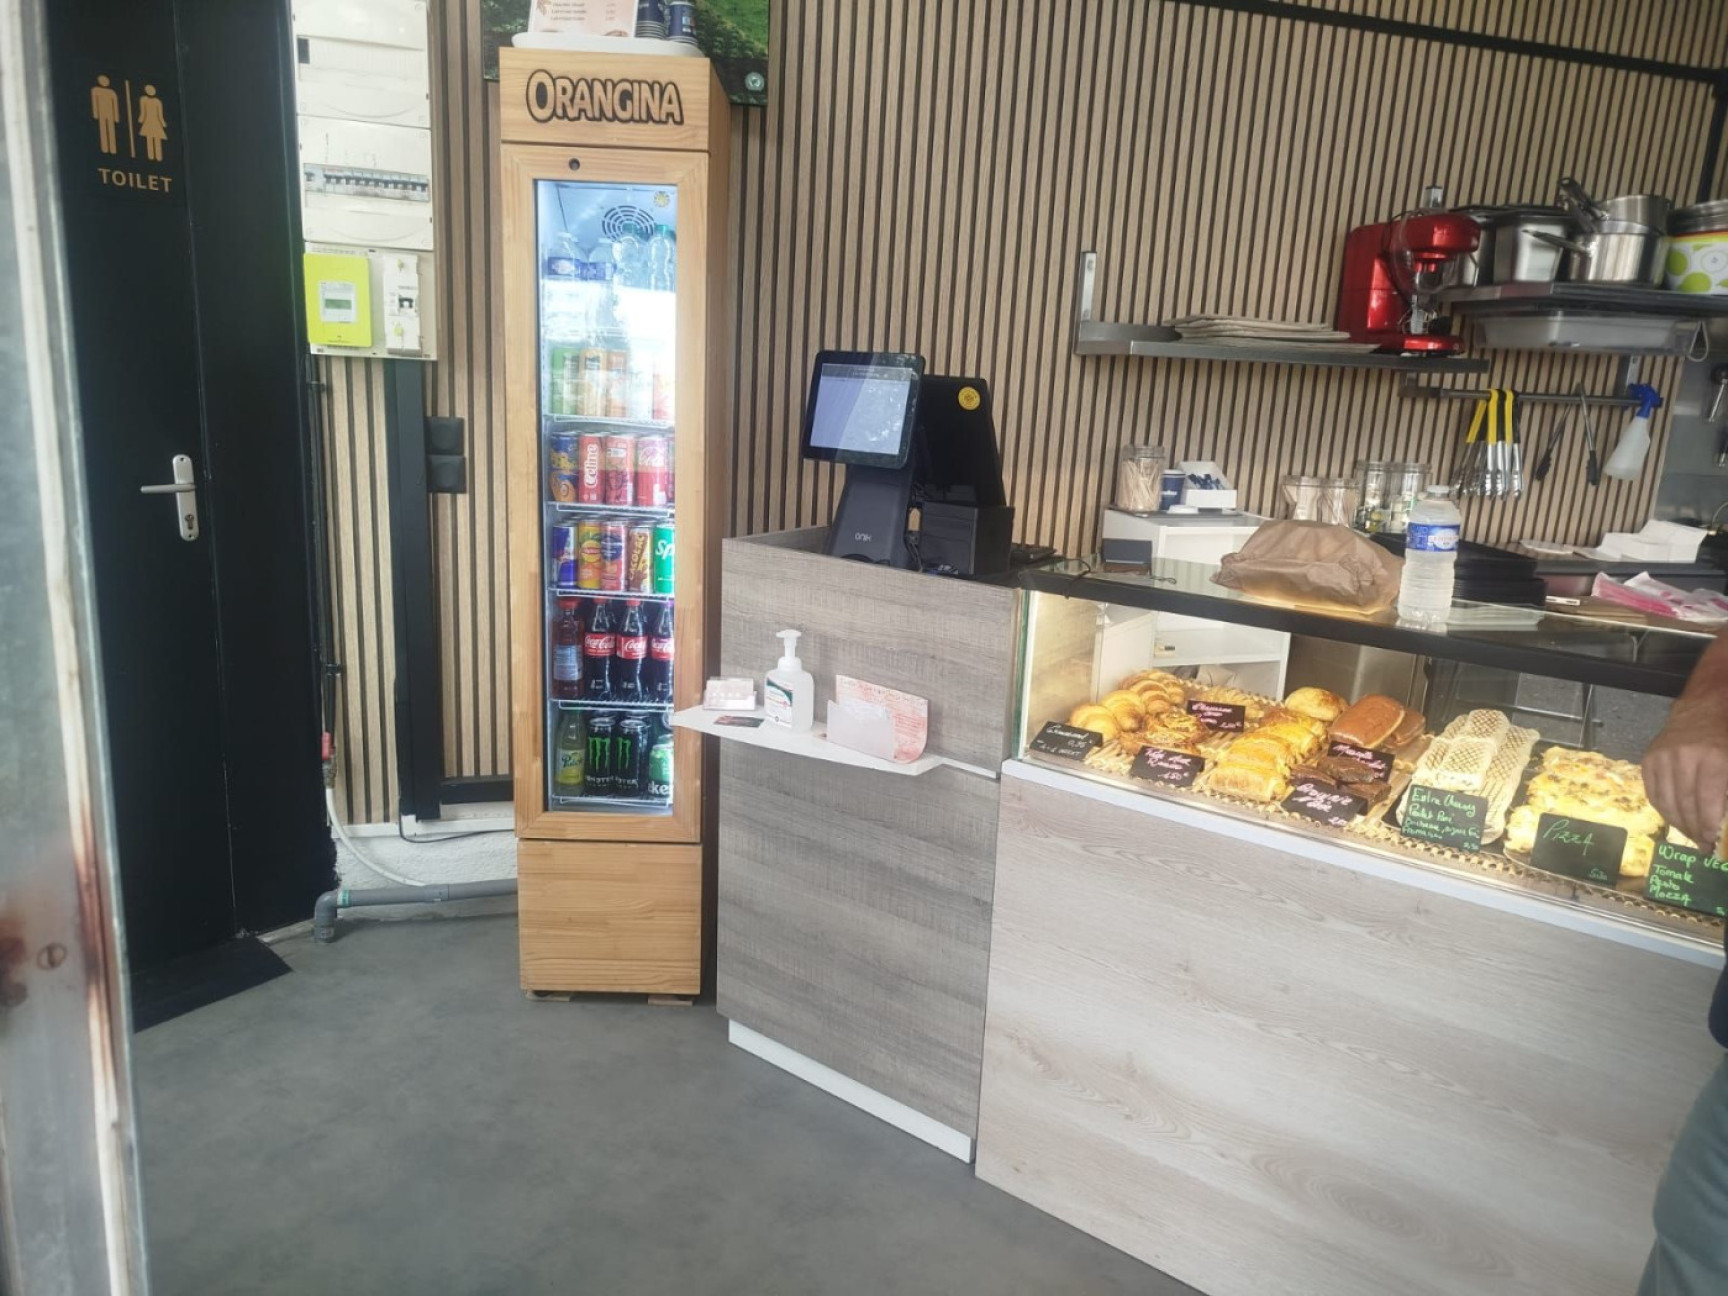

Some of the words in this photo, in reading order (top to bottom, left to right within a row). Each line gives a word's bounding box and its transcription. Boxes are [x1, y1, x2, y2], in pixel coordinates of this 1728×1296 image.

[526, 69, 684, 125] ORANGINA
[98, 168, 172, 192] TOILET
[1658, 844, 1697, 868] Wrap
